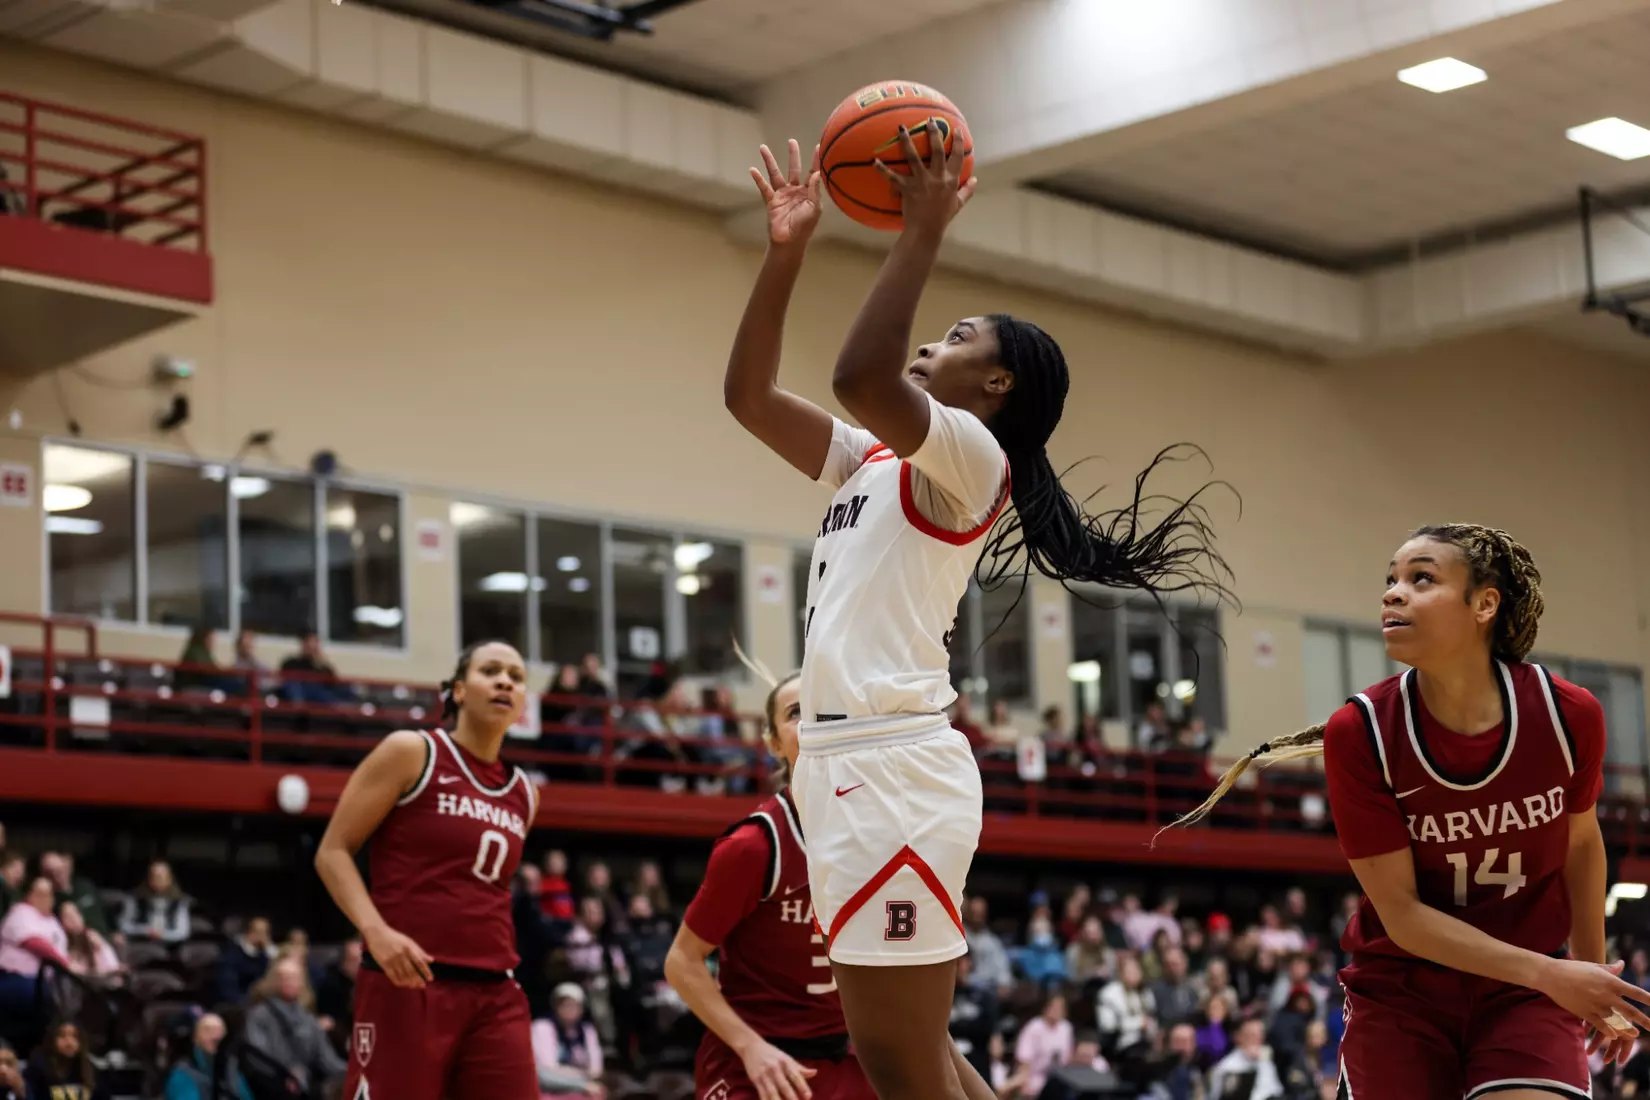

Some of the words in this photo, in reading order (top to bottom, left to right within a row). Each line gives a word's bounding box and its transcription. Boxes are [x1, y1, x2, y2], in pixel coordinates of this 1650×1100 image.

[472, 829, 509, 884] 0
[1446, 848, 1527, 907] 14
[884, 900, 917, 941] B
